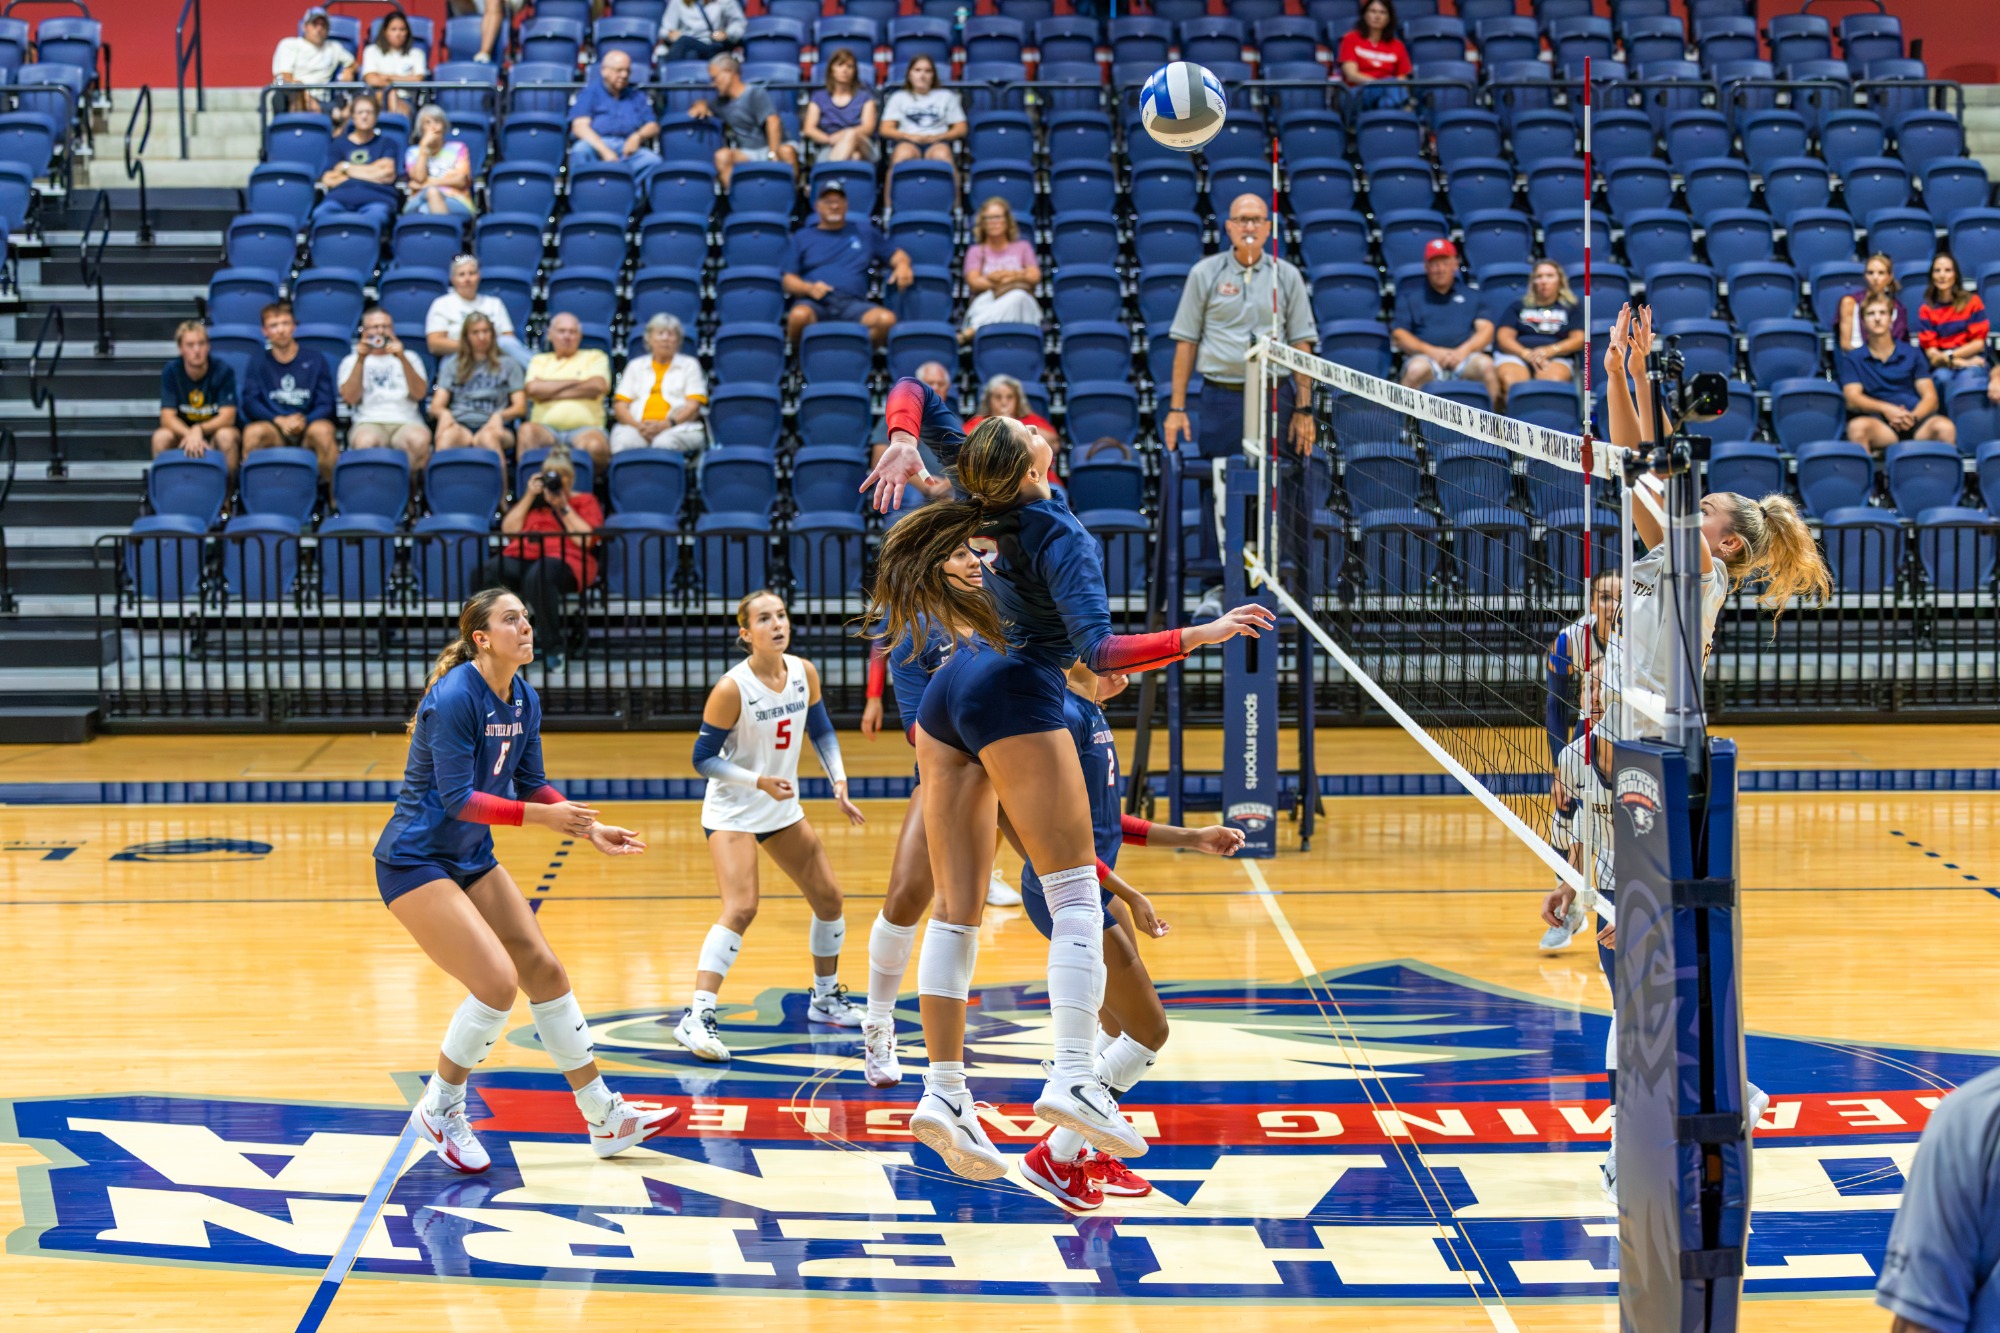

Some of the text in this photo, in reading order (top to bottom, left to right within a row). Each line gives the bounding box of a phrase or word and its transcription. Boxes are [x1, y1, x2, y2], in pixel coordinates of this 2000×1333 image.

[755, 701, 806, 721] SOUTHERN INDIANA
[775, 718, 791, 750] 5
[1243, 693, 1259, 790] sports imports
[1106, 747, 1115, 787] 2
[1616, 779, 1662, 811] INDIANA
[640, 1103, 1161, 1138] EAGLE
